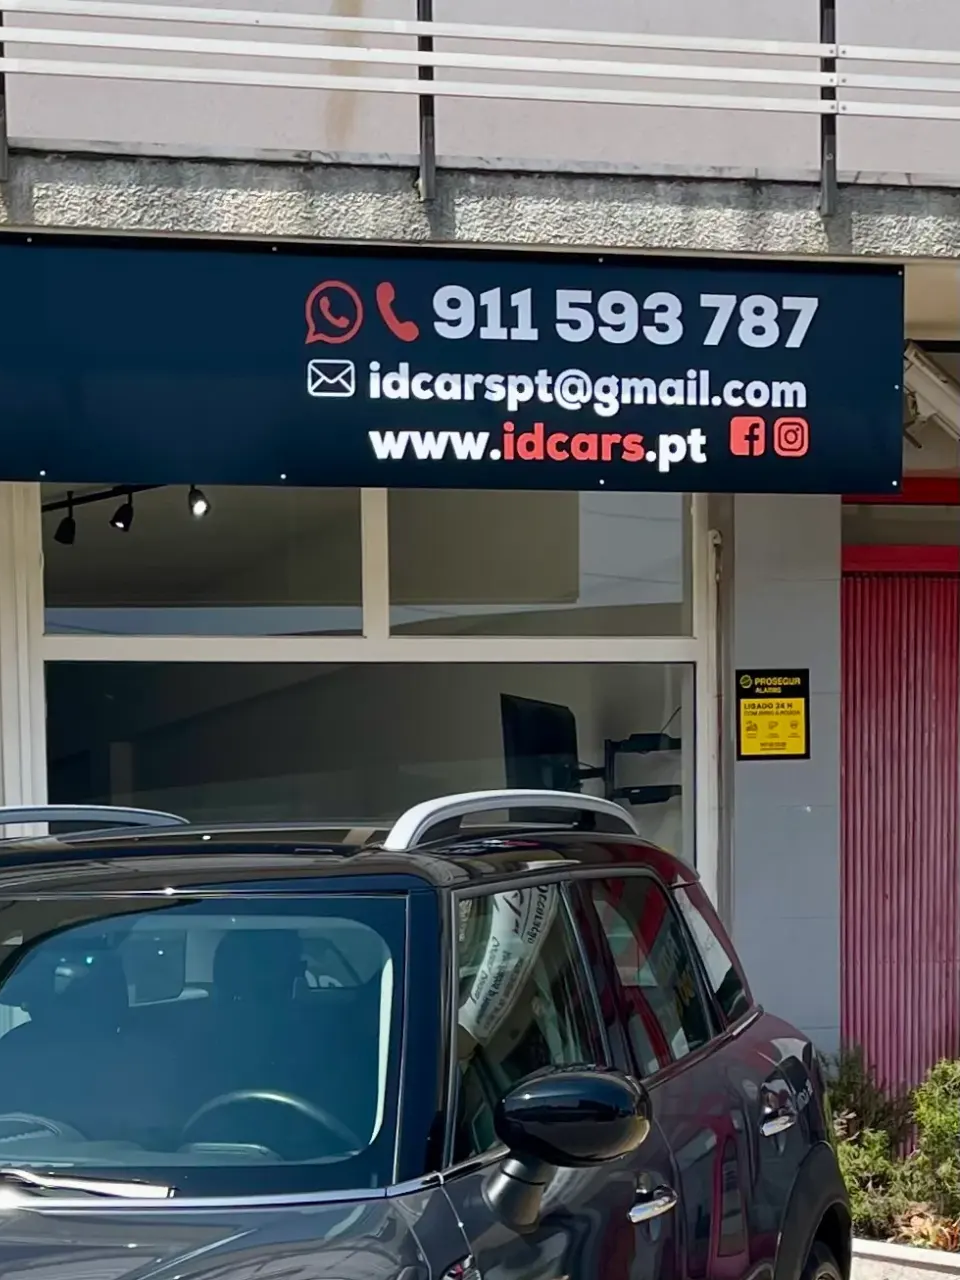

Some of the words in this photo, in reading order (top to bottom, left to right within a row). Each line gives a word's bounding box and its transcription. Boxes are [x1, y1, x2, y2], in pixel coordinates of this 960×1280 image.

[432, 284, 539, 341] 911
[555, 289, 684, 347] 593
[699, 294, 820, 349] 787
[368, 362, 808, 417] idcarspt@gmail.com
[368, 422, 708, 473] www.idcars.pt
[754, 677, 801, 686] PROSEGUR
